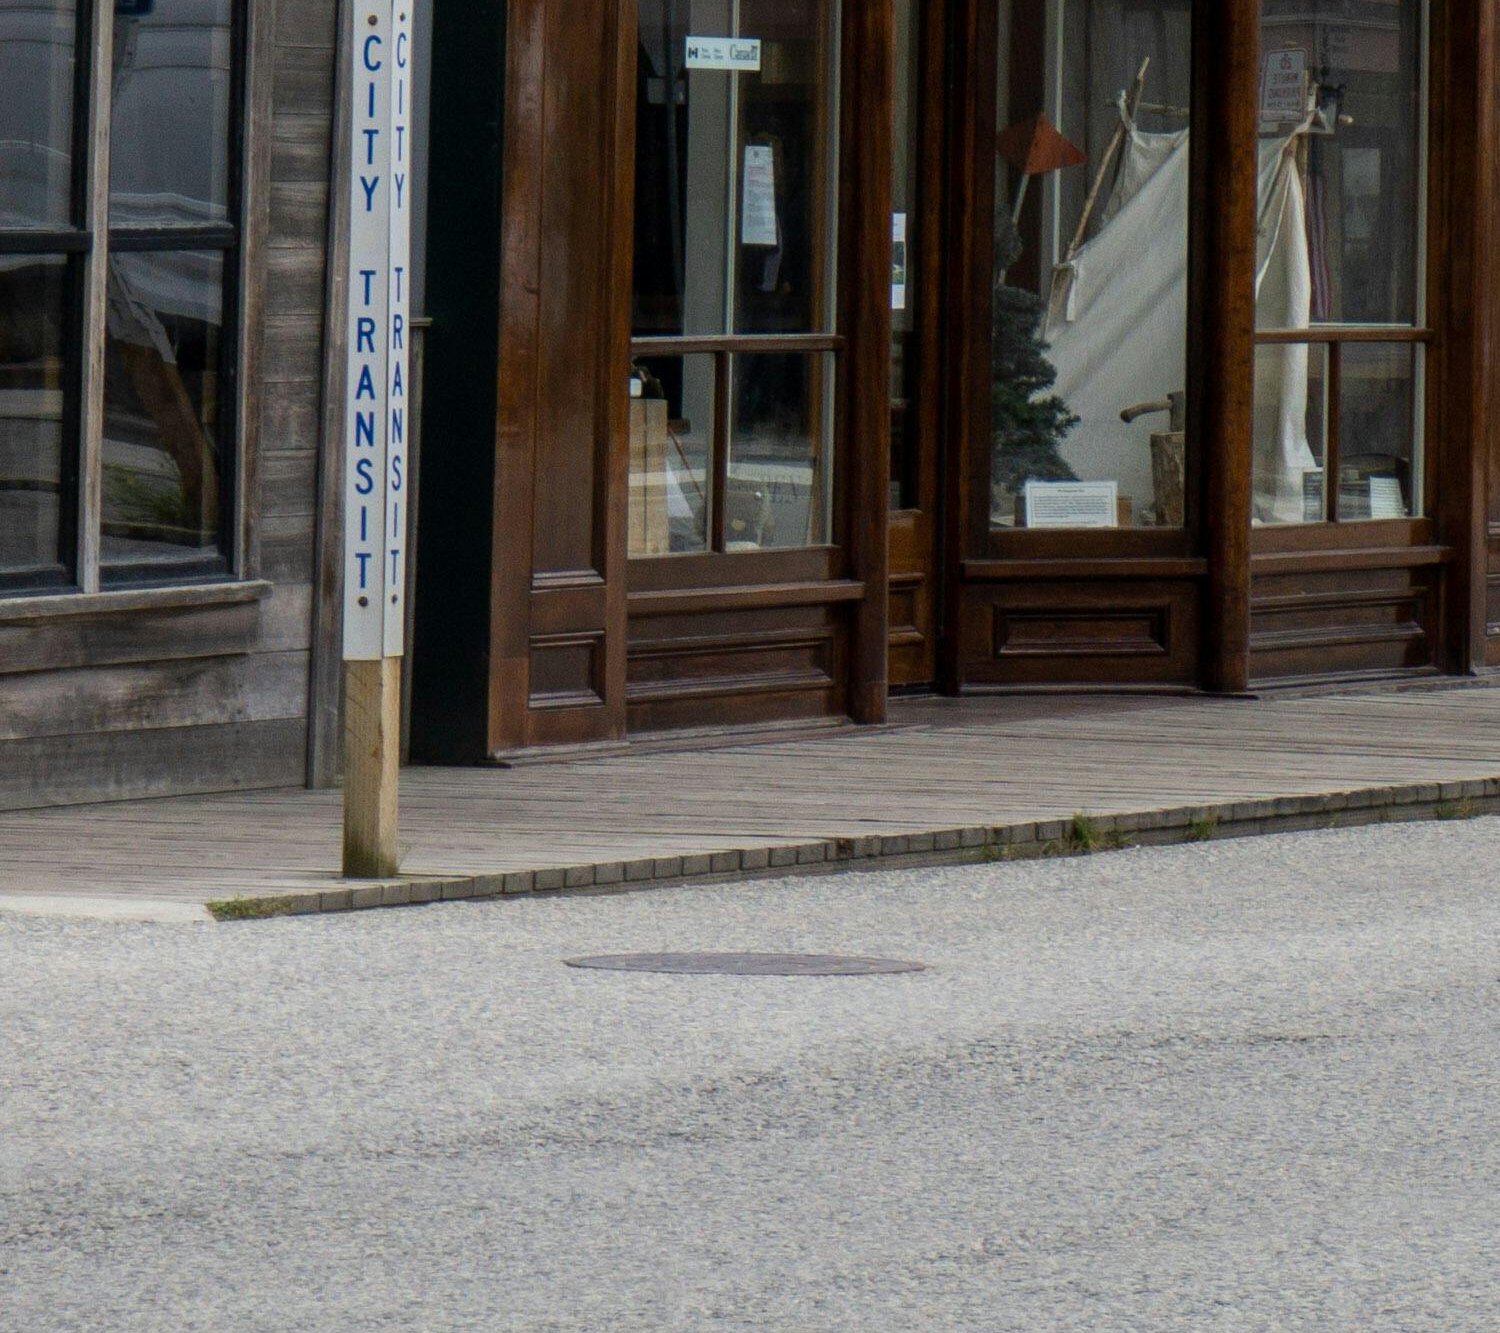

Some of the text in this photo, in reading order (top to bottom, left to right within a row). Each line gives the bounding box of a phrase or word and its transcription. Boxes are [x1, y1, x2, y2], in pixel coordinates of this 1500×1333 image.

[355, 35, 382, 589] CITY TRANSIT
[390, 32, 407, 585] CITY TRANSIT
